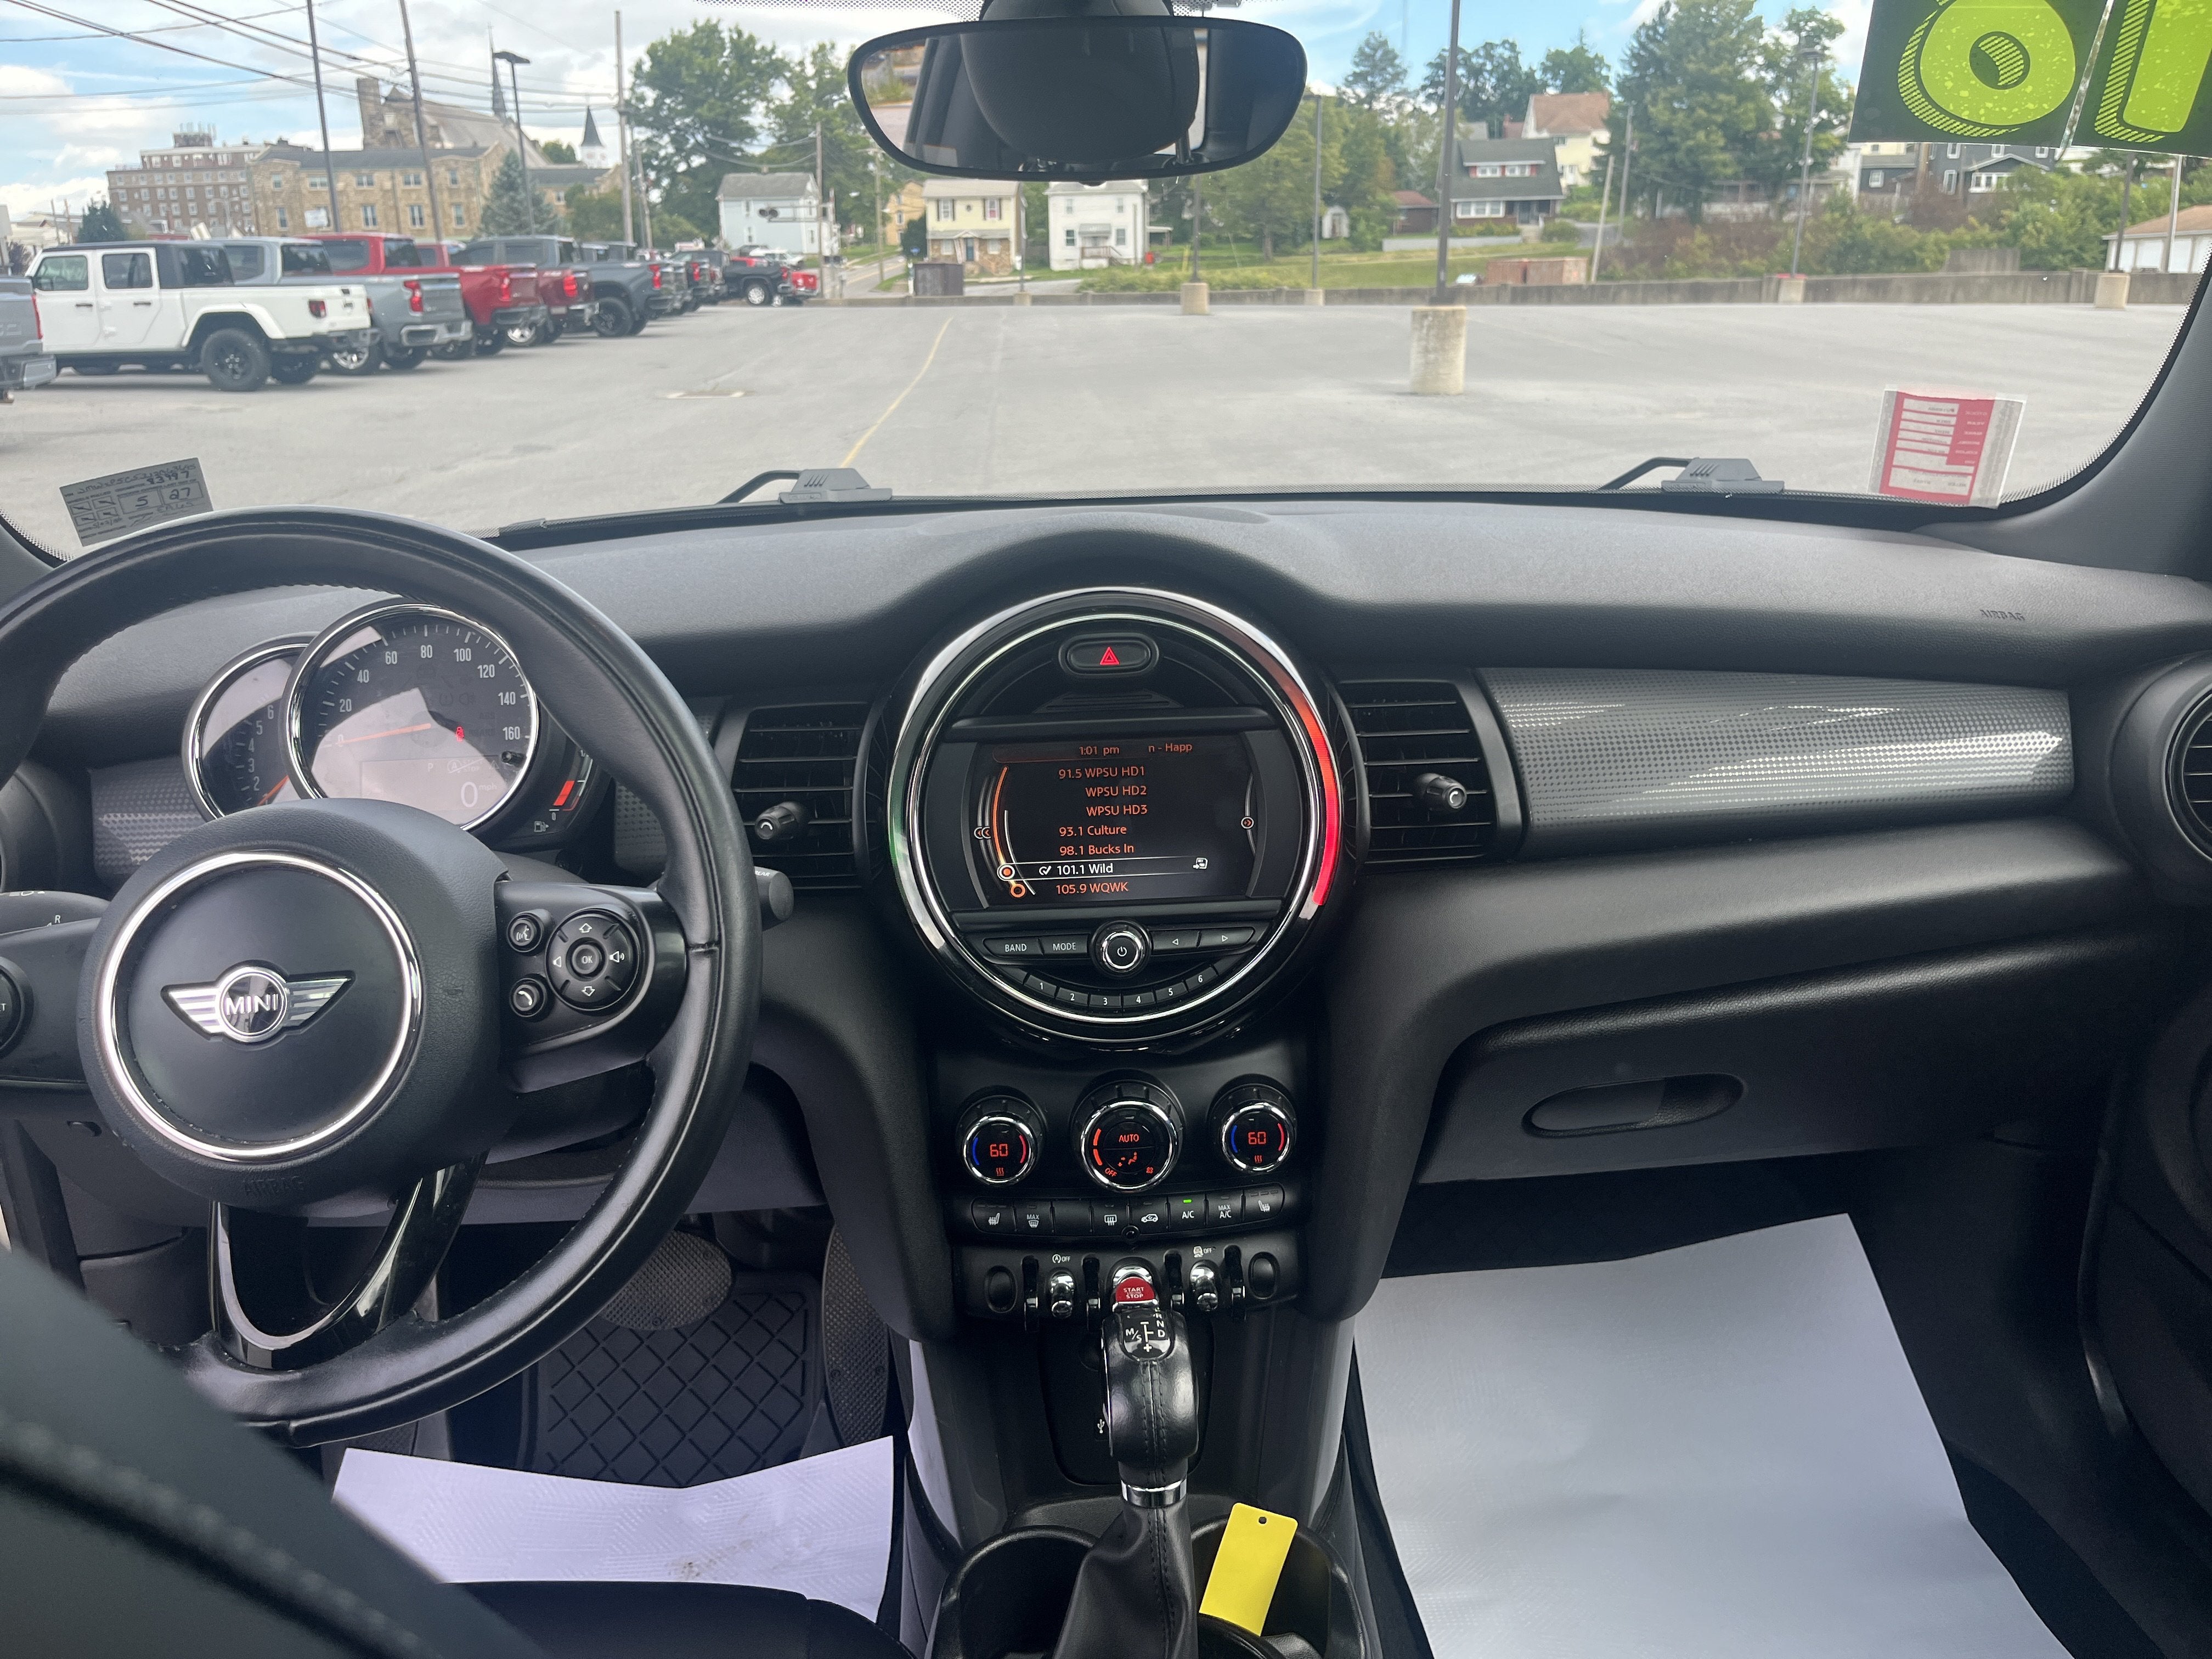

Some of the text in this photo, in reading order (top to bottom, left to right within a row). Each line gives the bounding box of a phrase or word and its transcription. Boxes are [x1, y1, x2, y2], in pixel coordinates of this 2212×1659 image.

[385, 651, 398, 665] 60
[421, 645, 433, 658] 80
[454, 648, 472, 662] 100
[357, 670, 370, 683] 40
[477, 664, 495, 679] 120
[340, 699, 352, 712] 20
[498, 692, 516, 706] 140
[267, 704, 274, 719] 6
[256, 720, 263, 735] 5
[503, 726, 521, 741] 160
[248, 738, 255, 753] 4
[1079, 746, 1098, 755] 1:01
[1103, 747, 1120, 757] pm
[1165, 743, 1193, 754] Happ
[248, 758, 255, 772] 3
[1058, 766, 1146, 779] 91.5 WPSU HD1
[253, 776, 259, 791] 2
[1085, 785, 1147, 797] WPSU HD2
[1086, 804, 1148, 816] WPSU HD3
[1059, 825, 1127, 837] 93.1 Culture
[1059, 843, 1135, 856] 98.1 Bucks In
[1057, 863, 1114, 875] 101.1 Wild
[1056, 882, 1128, 895] 105.9 WQWK
[55, 915, 61, 924] R
[1005, 941, 1076, 953] BAND MODE
[582, 956, 593, 964] OK
[1070, 993, 1075, 1001] 2
[1103, 997, 1108, 1006] 3
[1136, 995, 1142, 1004] 4
[1168, 988, 1173, 996] 5
[1198, 975, 1203, 983] 6
[225, 994, 279, 1016] MINI
[1119, 1133, 1139, 1143] AUTO
[1248, 1132, 1267, 1146] 60
[990, 1144, 1008, 1157] 60
[1104, 1167, 1118, 1178] OFF
[1182, 1210, 1195, 1220] A/C
[1219, 1210, 1232, 1219] A/C
[1158, 1329, 1166, 1338] D
